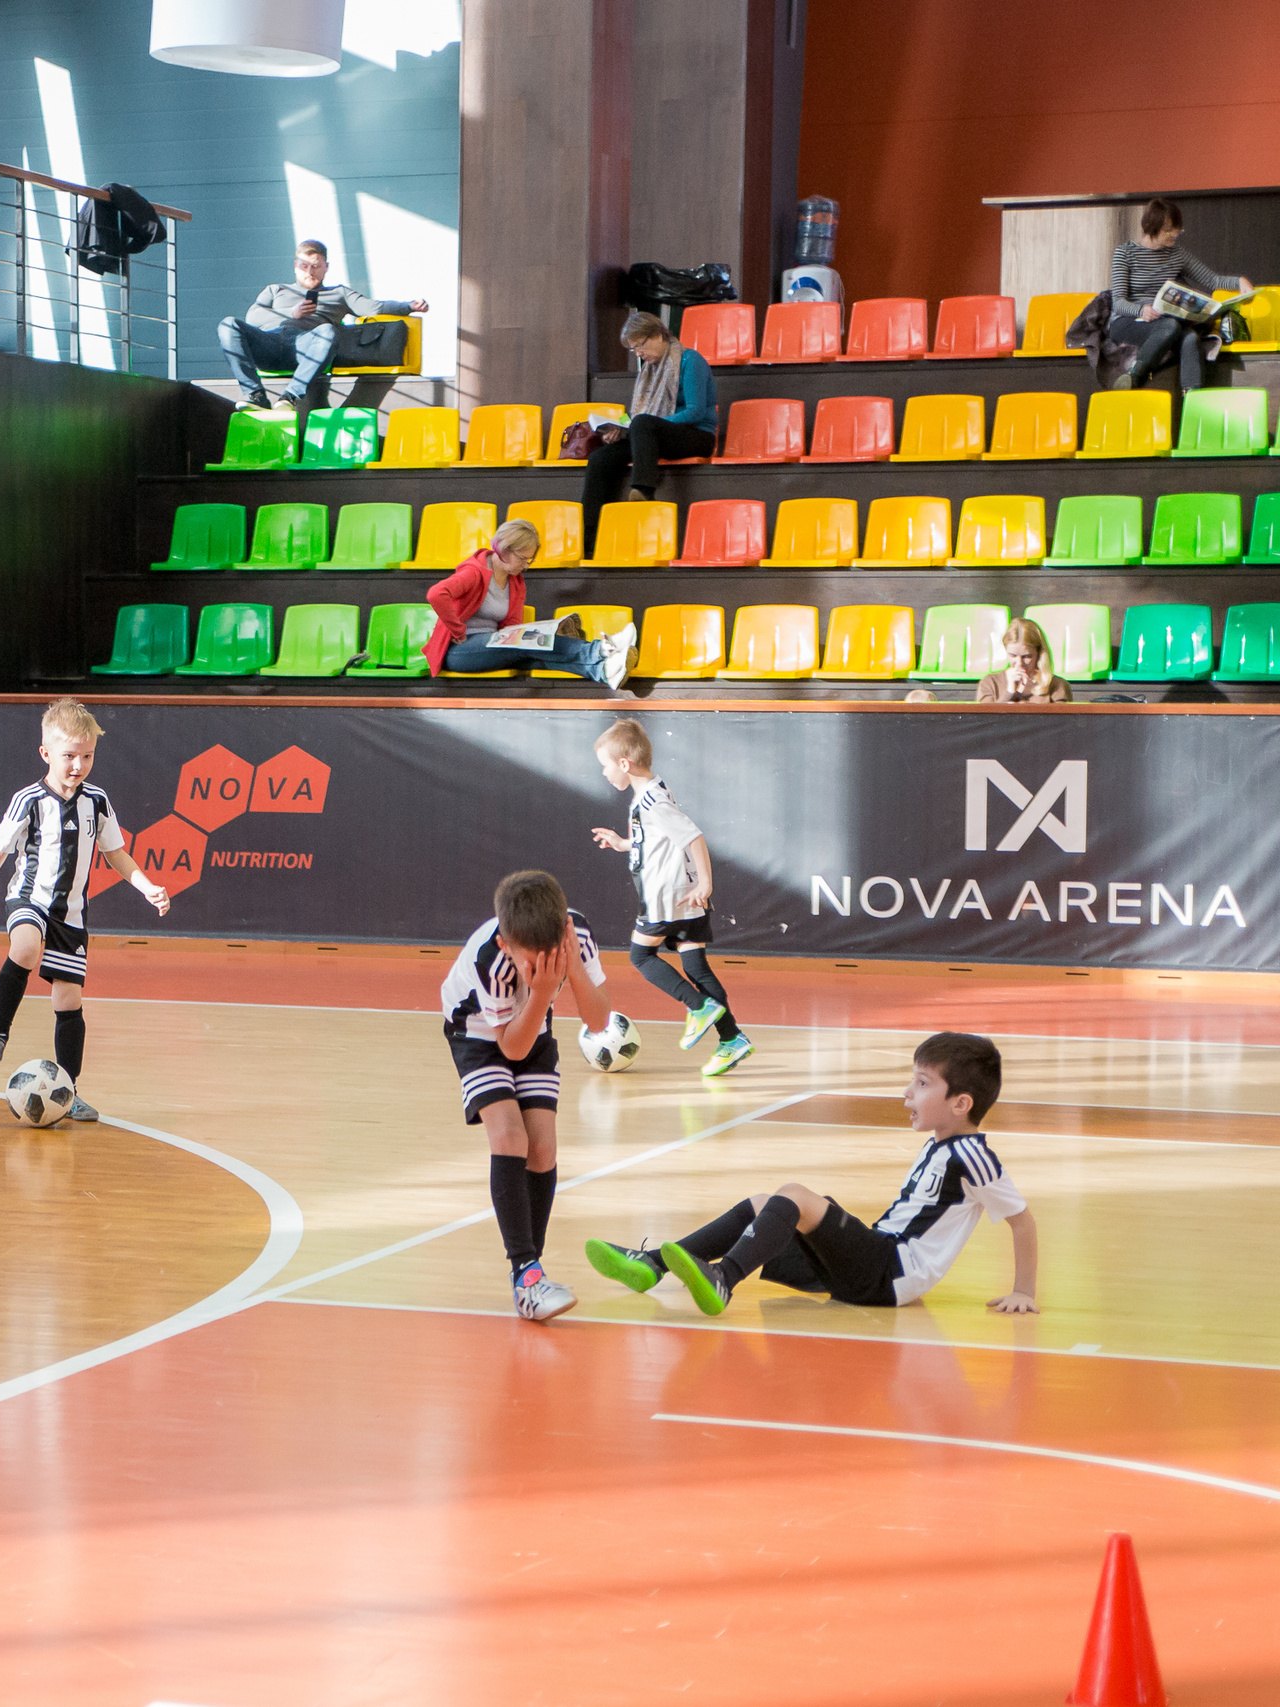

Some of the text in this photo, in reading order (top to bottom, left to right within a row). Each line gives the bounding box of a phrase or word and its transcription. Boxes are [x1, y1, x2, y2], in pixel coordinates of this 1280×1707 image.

[189, 777, 313, 801] NOVA
[210, 851, 313, 870] NUTRITION
[811, 875, 1247, 928] NOVA ARENA
